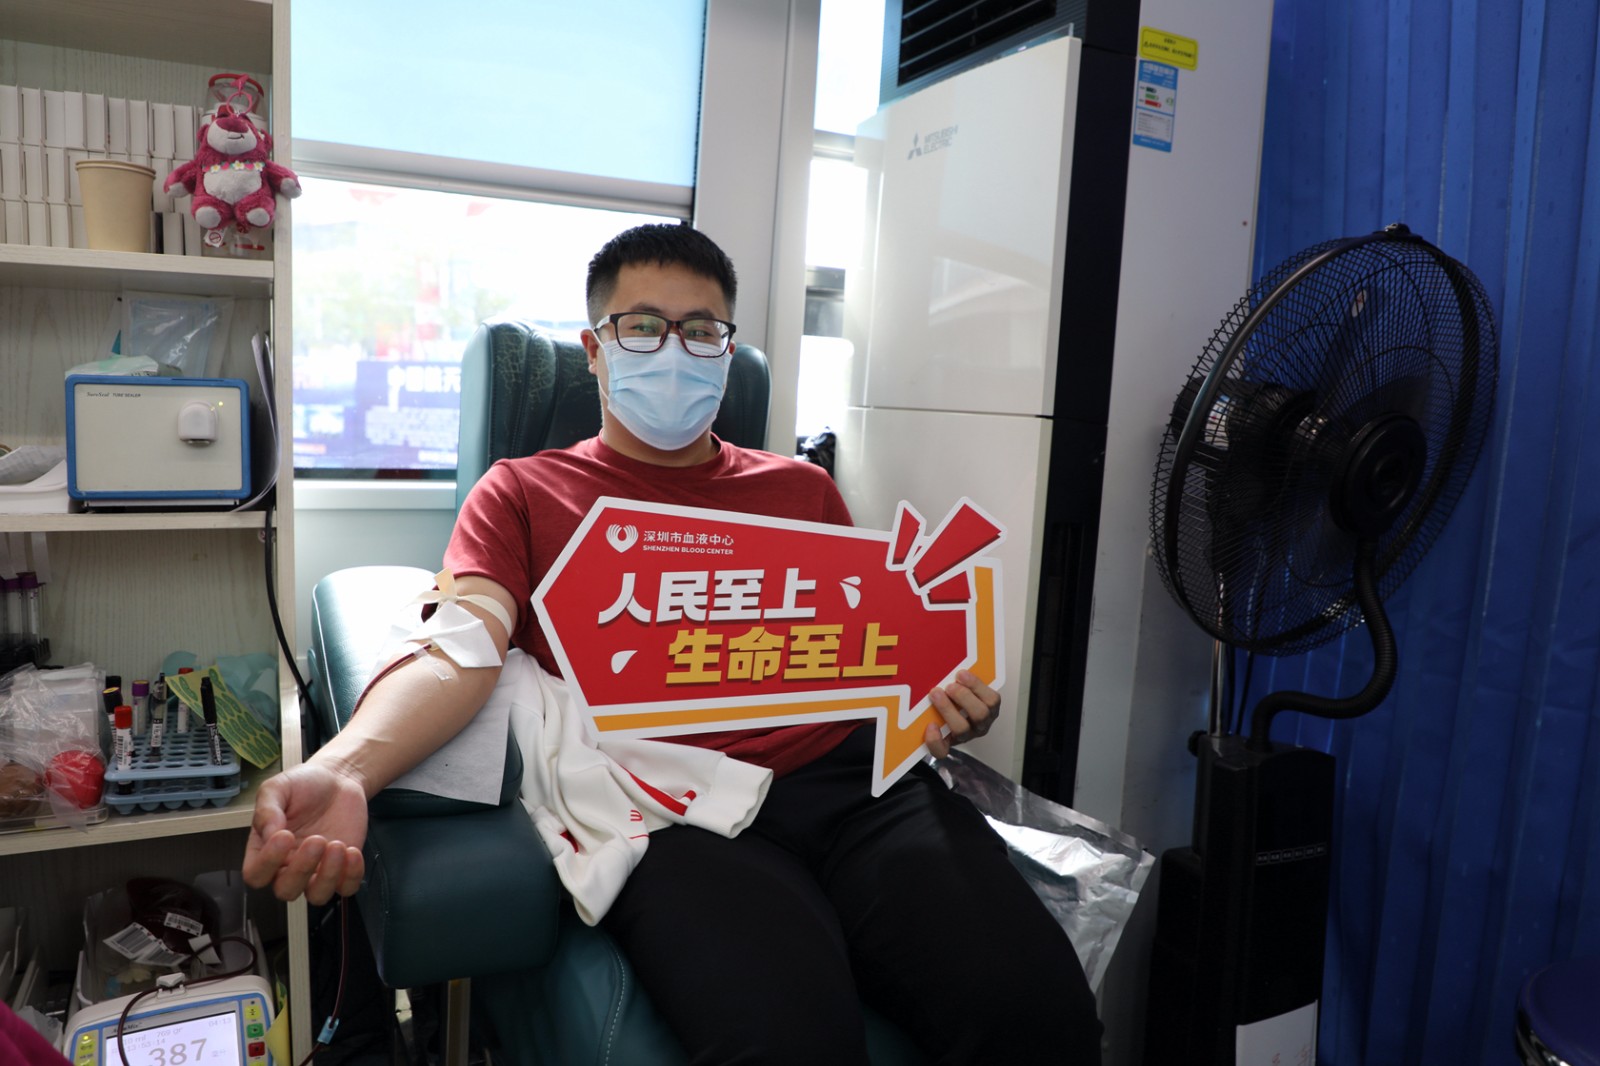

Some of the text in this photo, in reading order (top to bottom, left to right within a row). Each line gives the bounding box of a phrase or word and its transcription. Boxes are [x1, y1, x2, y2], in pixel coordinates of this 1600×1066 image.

[642, 545, 680, 553] SHENZHEN
[706, 547, 734, 555] CENTER
[643, 530, 734, 546] 深圳市血液中心
[597, 567, 816, 625] 人民至上
[665, 622, 898, 685] 生命至上
[148, 1038, 207, 1066] 387
